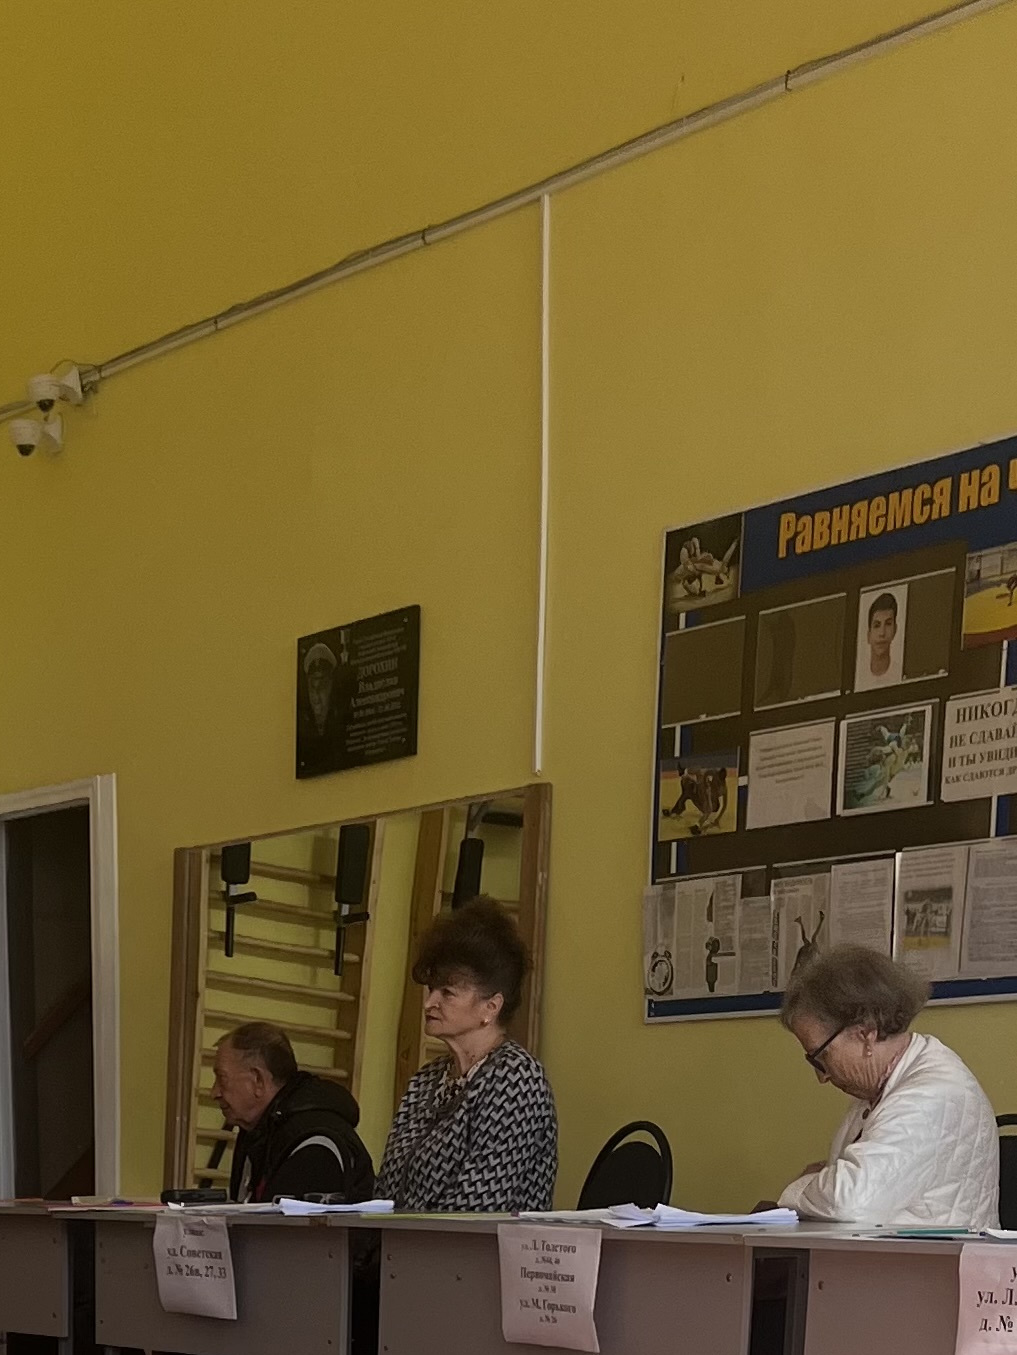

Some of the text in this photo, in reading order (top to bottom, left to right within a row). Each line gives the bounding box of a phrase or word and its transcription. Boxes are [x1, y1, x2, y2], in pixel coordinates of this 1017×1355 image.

[778, 476, 953, 560] Равняемся
[957, 463, 1001, 514] на
[949, 734, 967, 749] НЕ
[949, 757, 956, 768] И
[959, 753, 976, 768] ТЫ
[945, 775, 962, 785] КАК
[962, 767, 1005, 783] СДАЮТСЯ
[180, 1245, 222, 1260] Советская
[542, 1240, 576, 1253] Толстого
[520, 1266, 575, 1282] Первомайская
[976, 1288, 1017, 1308] ул. Л.
[543, 1299, 576, 1313] Горького
[979, 1315, 1013, 1332] д. №
